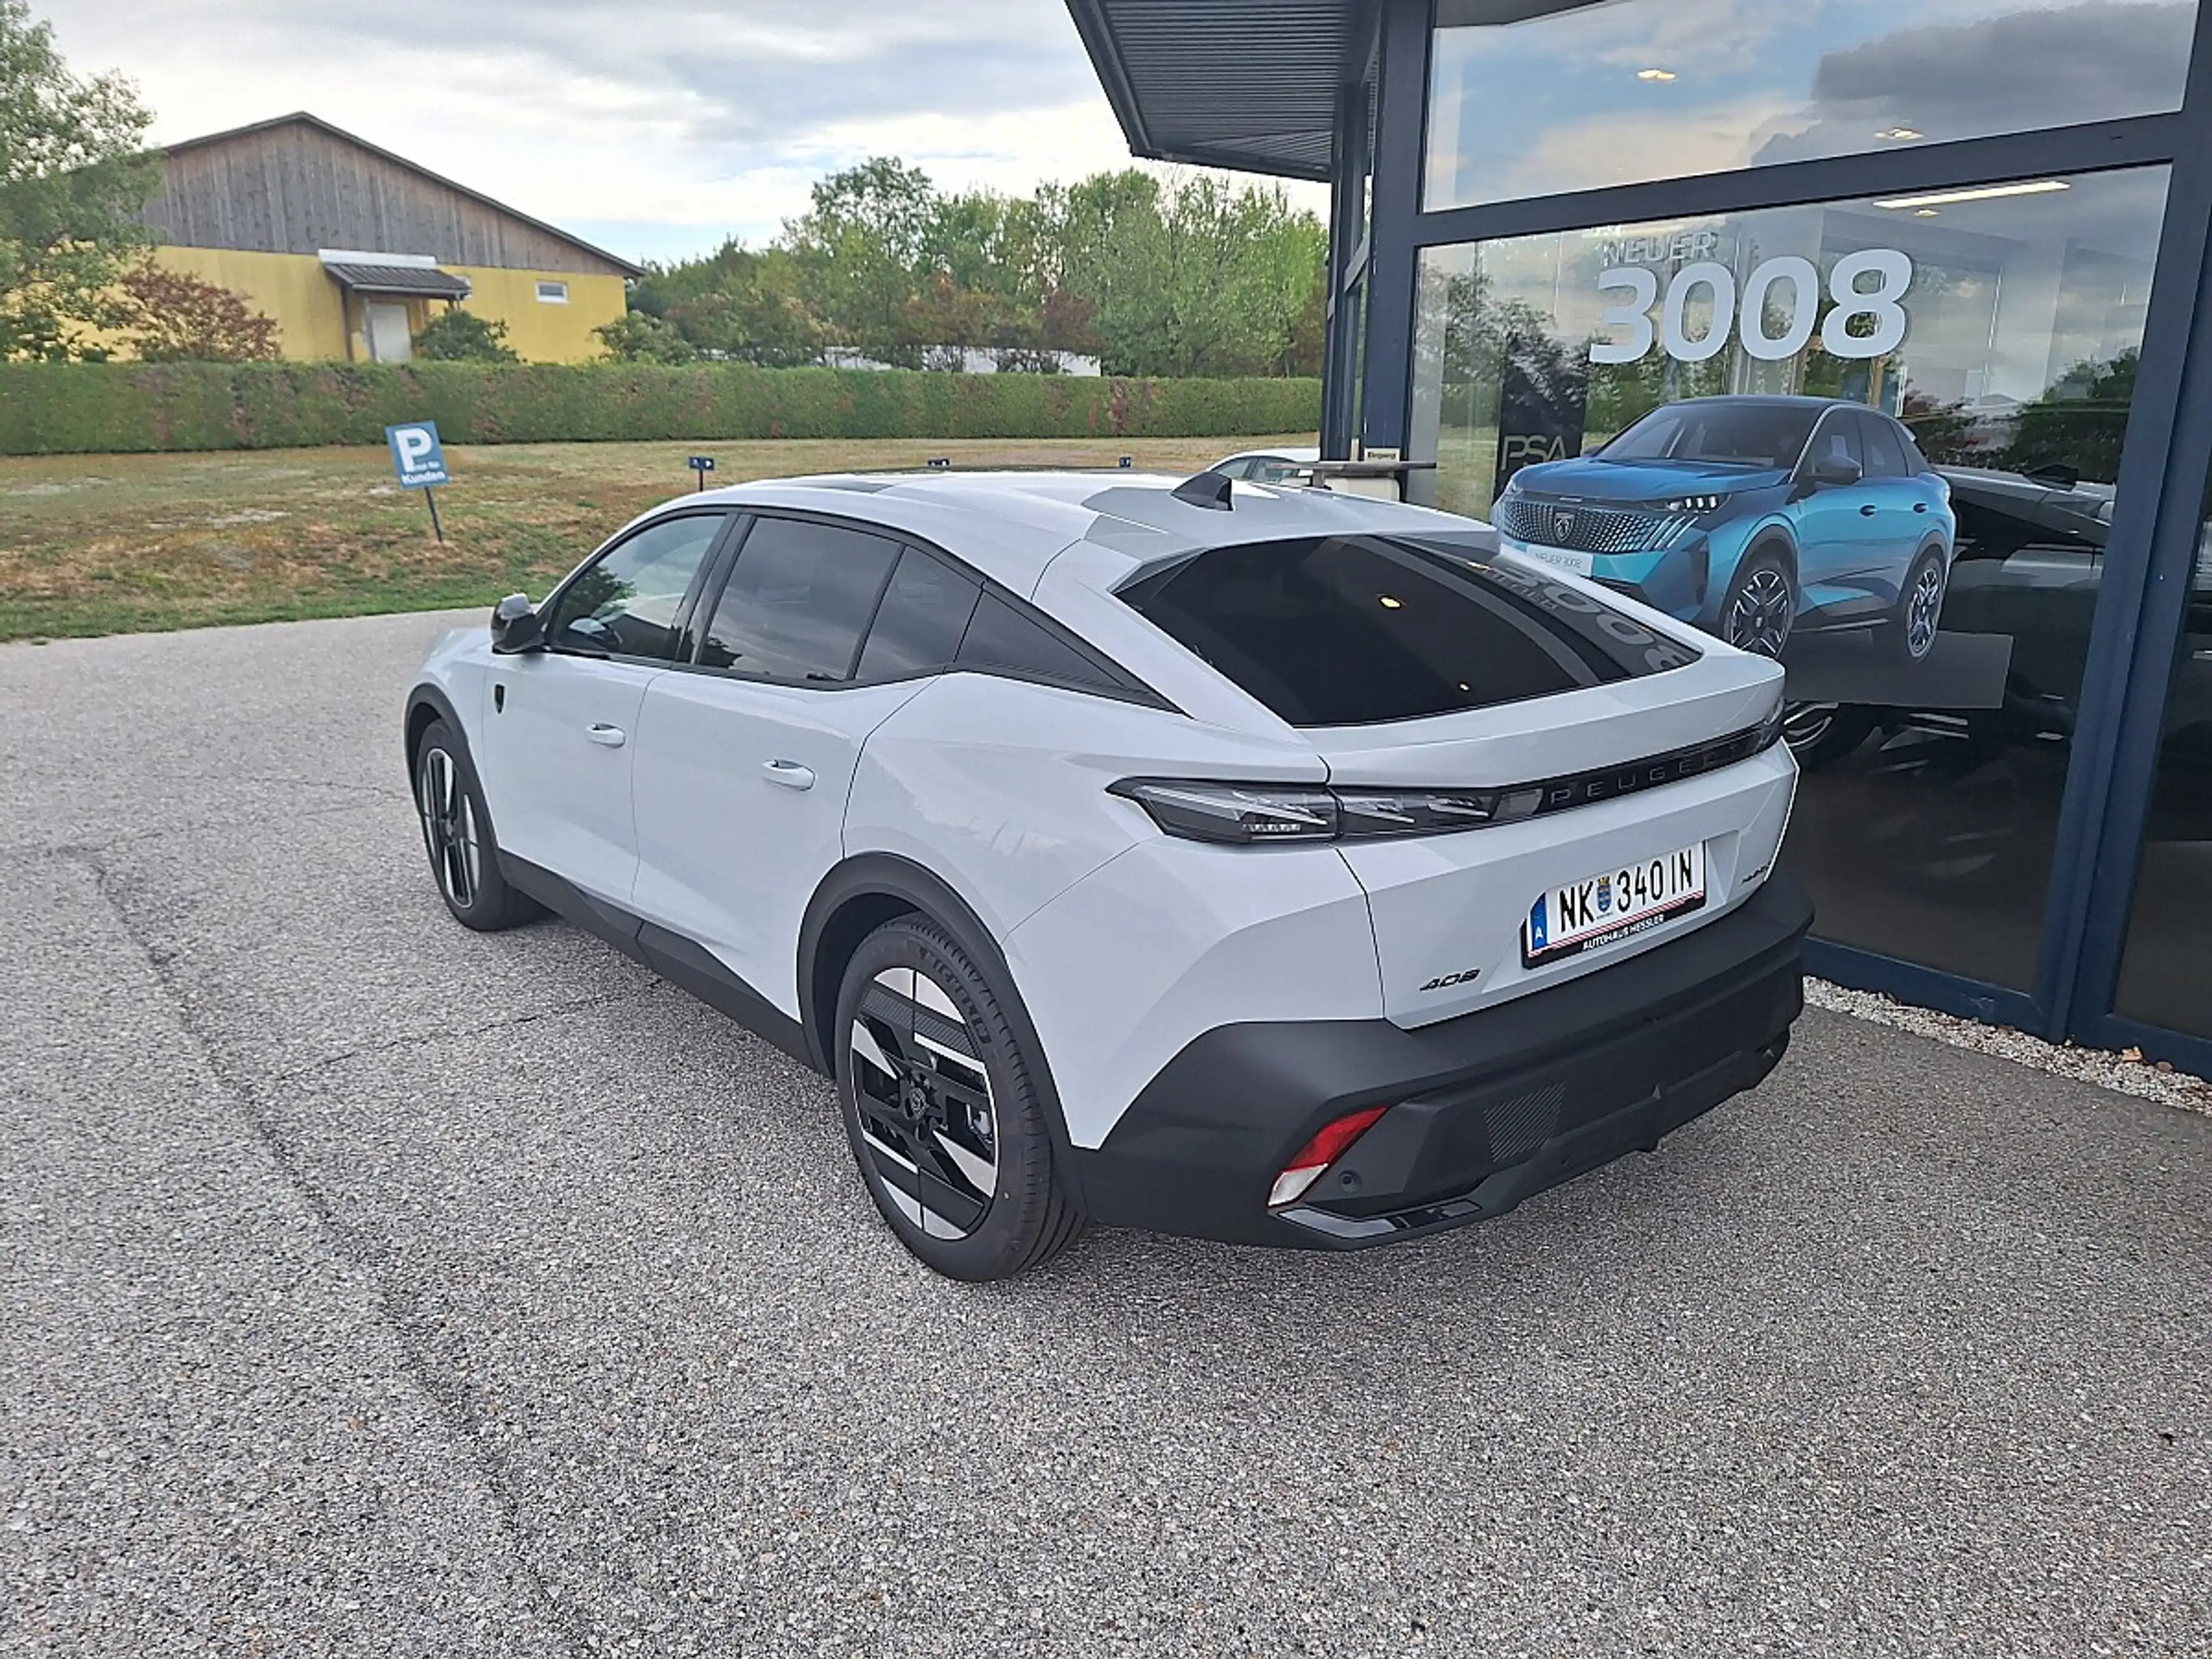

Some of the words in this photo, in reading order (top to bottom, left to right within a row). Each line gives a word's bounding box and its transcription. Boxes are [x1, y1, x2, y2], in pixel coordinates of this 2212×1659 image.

[1601, 232, 1714, 266] NEUER
[1589, 249, 1913, 363] 3008
[395, 428, 431, 472] P
[1501, 435, 1566, 471] PSA
[1559, 881, 1594, 933] NK
[1616, 860, 1664, 912] 340
[1672, 849, 1692, 895] IN
[1535, 926, 1543, 940] A
[1582, 926, 1629, 950] AUTOHAUS
[1629, 914, 1664, 934] HESSLER
[1419, 968, 1481, 991] 408
